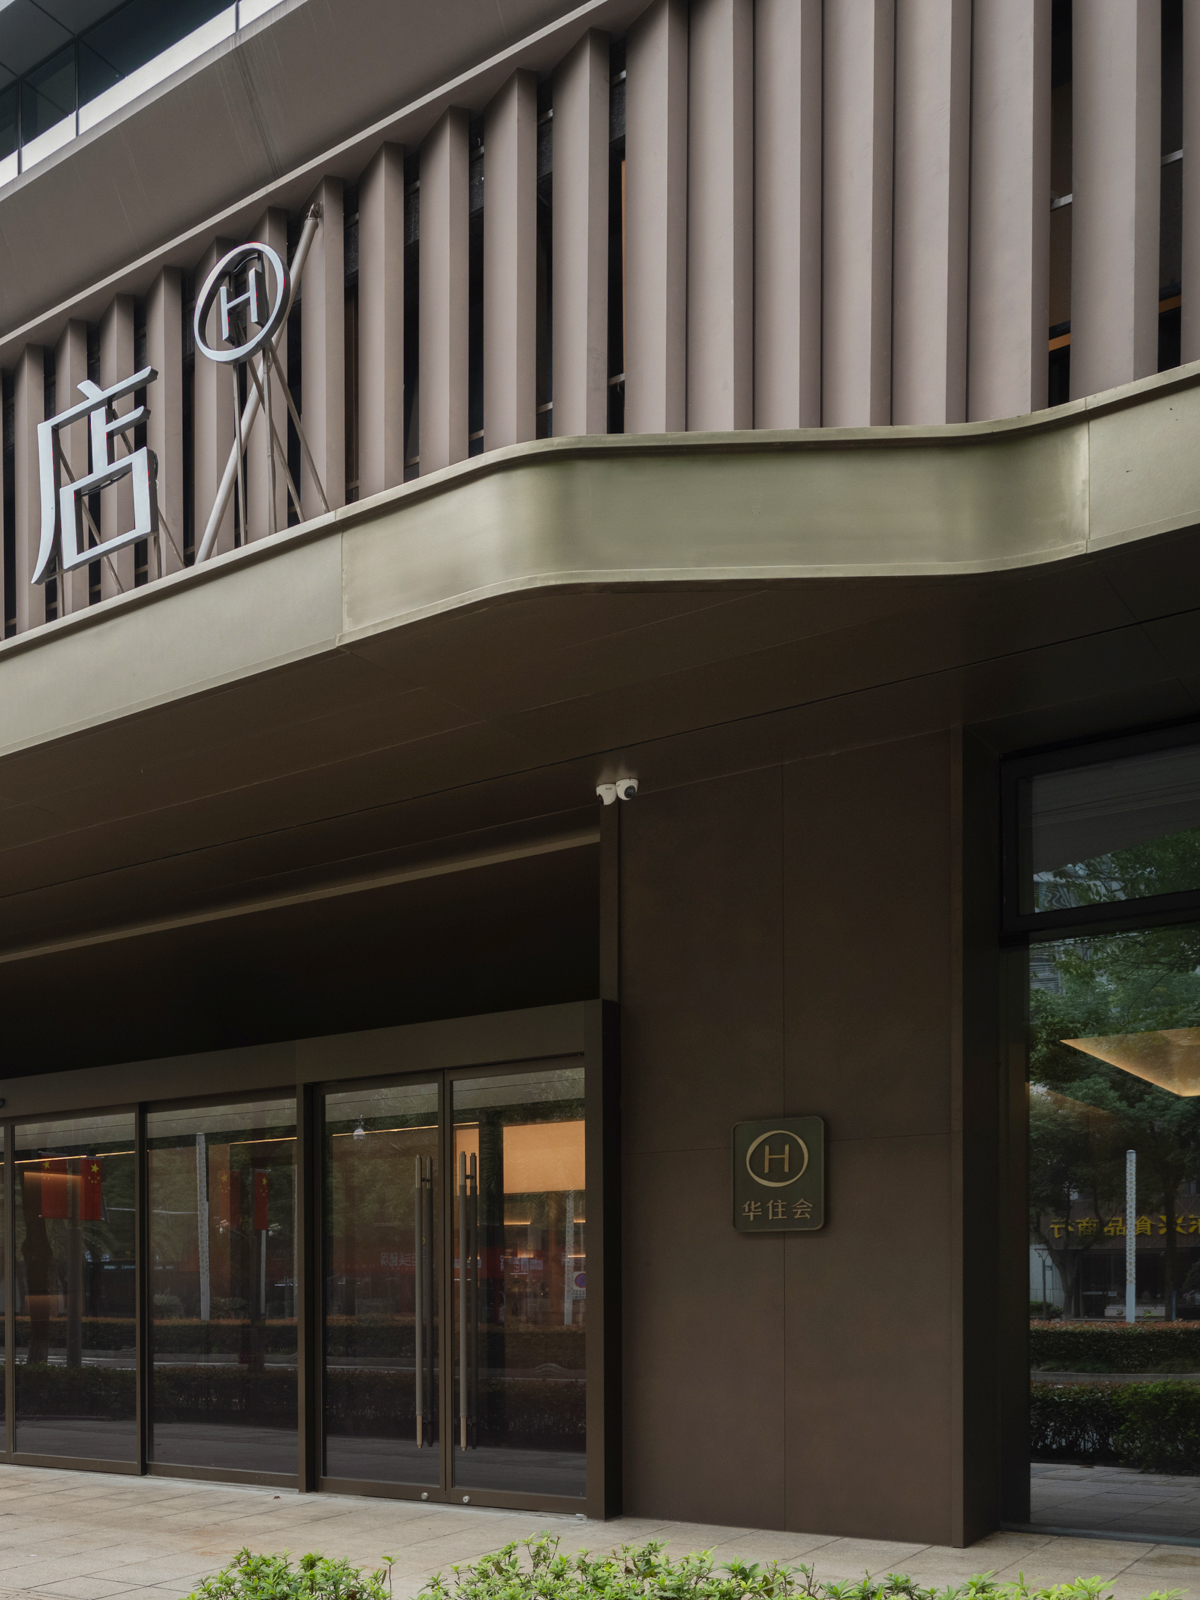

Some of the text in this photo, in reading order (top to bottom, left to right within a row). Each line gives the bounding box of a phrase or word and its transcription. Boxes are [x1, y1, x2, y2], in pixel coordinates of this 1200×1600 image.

[764, 1143, 790, 1174] H
[742, 1198, 813, 1221] 华住会
